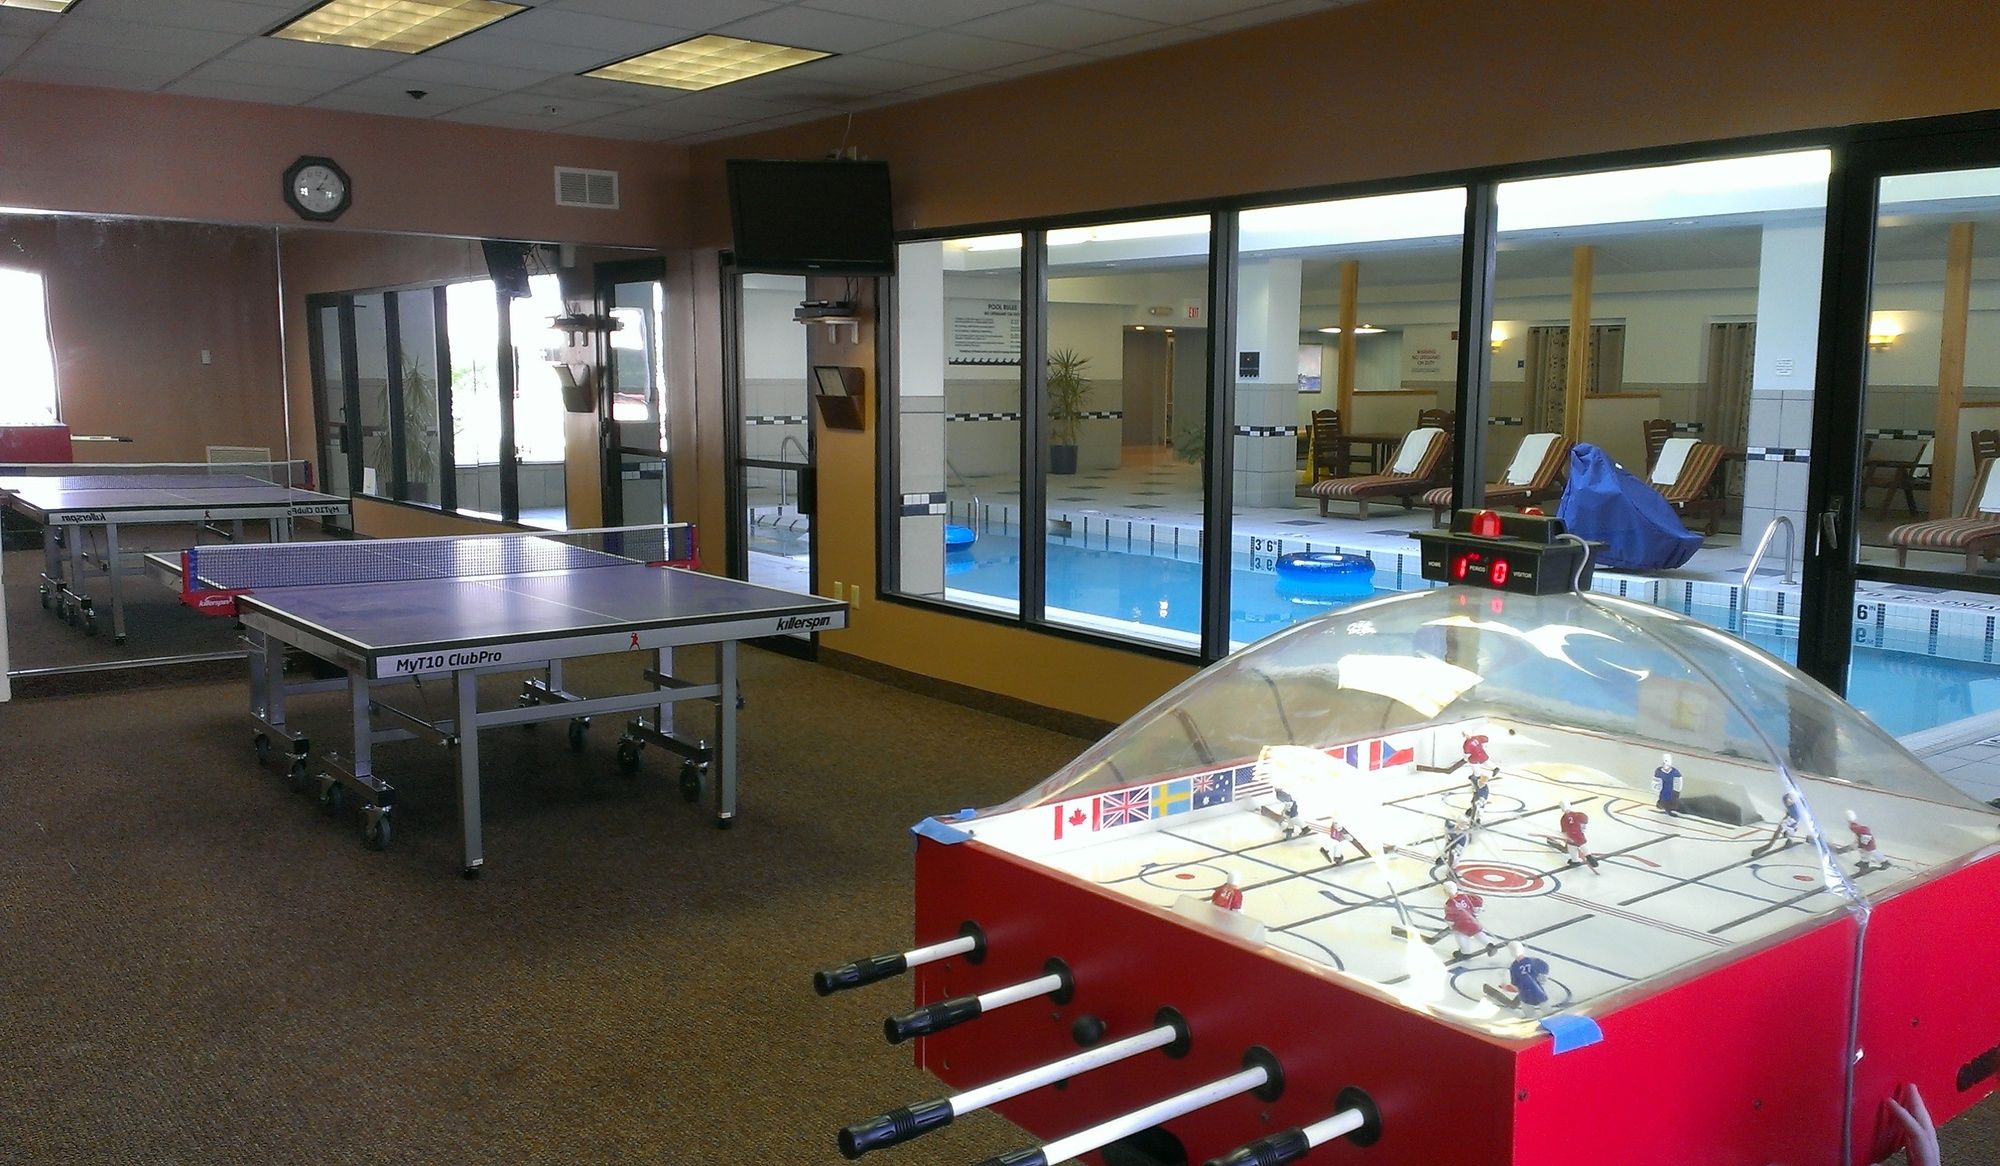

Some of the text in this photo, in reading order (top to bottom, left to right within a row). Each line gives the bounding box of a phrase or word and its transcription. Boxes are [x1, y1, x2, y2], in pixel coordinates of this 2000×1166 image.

[776, 616, 831, 631] killerspin
[397, 651, 502, 674] MyT10 ClubPro
[1519, 963, 1532, 974] 27
